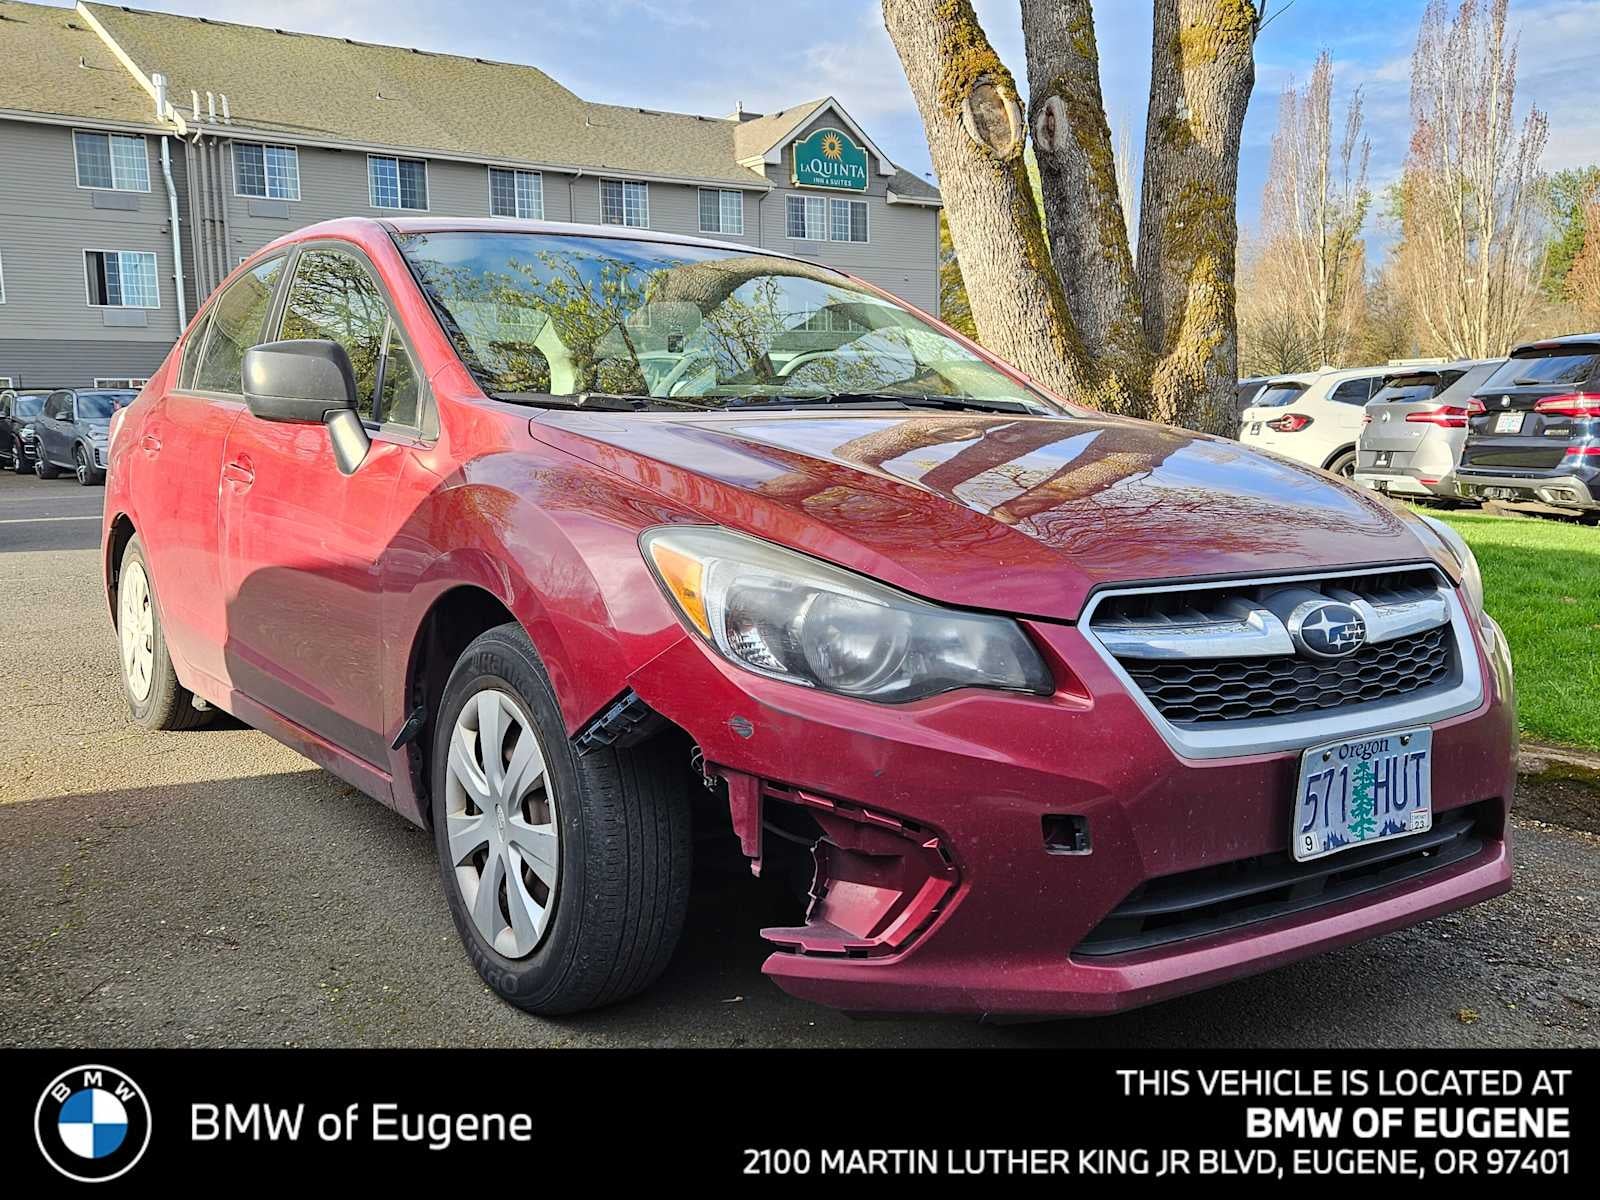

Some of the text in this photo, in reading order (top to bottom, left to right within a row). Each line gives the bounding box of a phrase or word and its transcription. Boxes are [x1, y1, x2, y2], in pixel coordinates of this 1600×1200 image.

[800, 158, 865, 178] LA QUINTA
[1339, 738, 1389, 760] Oregon
[1302, 752, 1426, 832] 571 HUT
[1414, 820, 1425, 829] 23
[1305, 836, 1313, 851] 9
